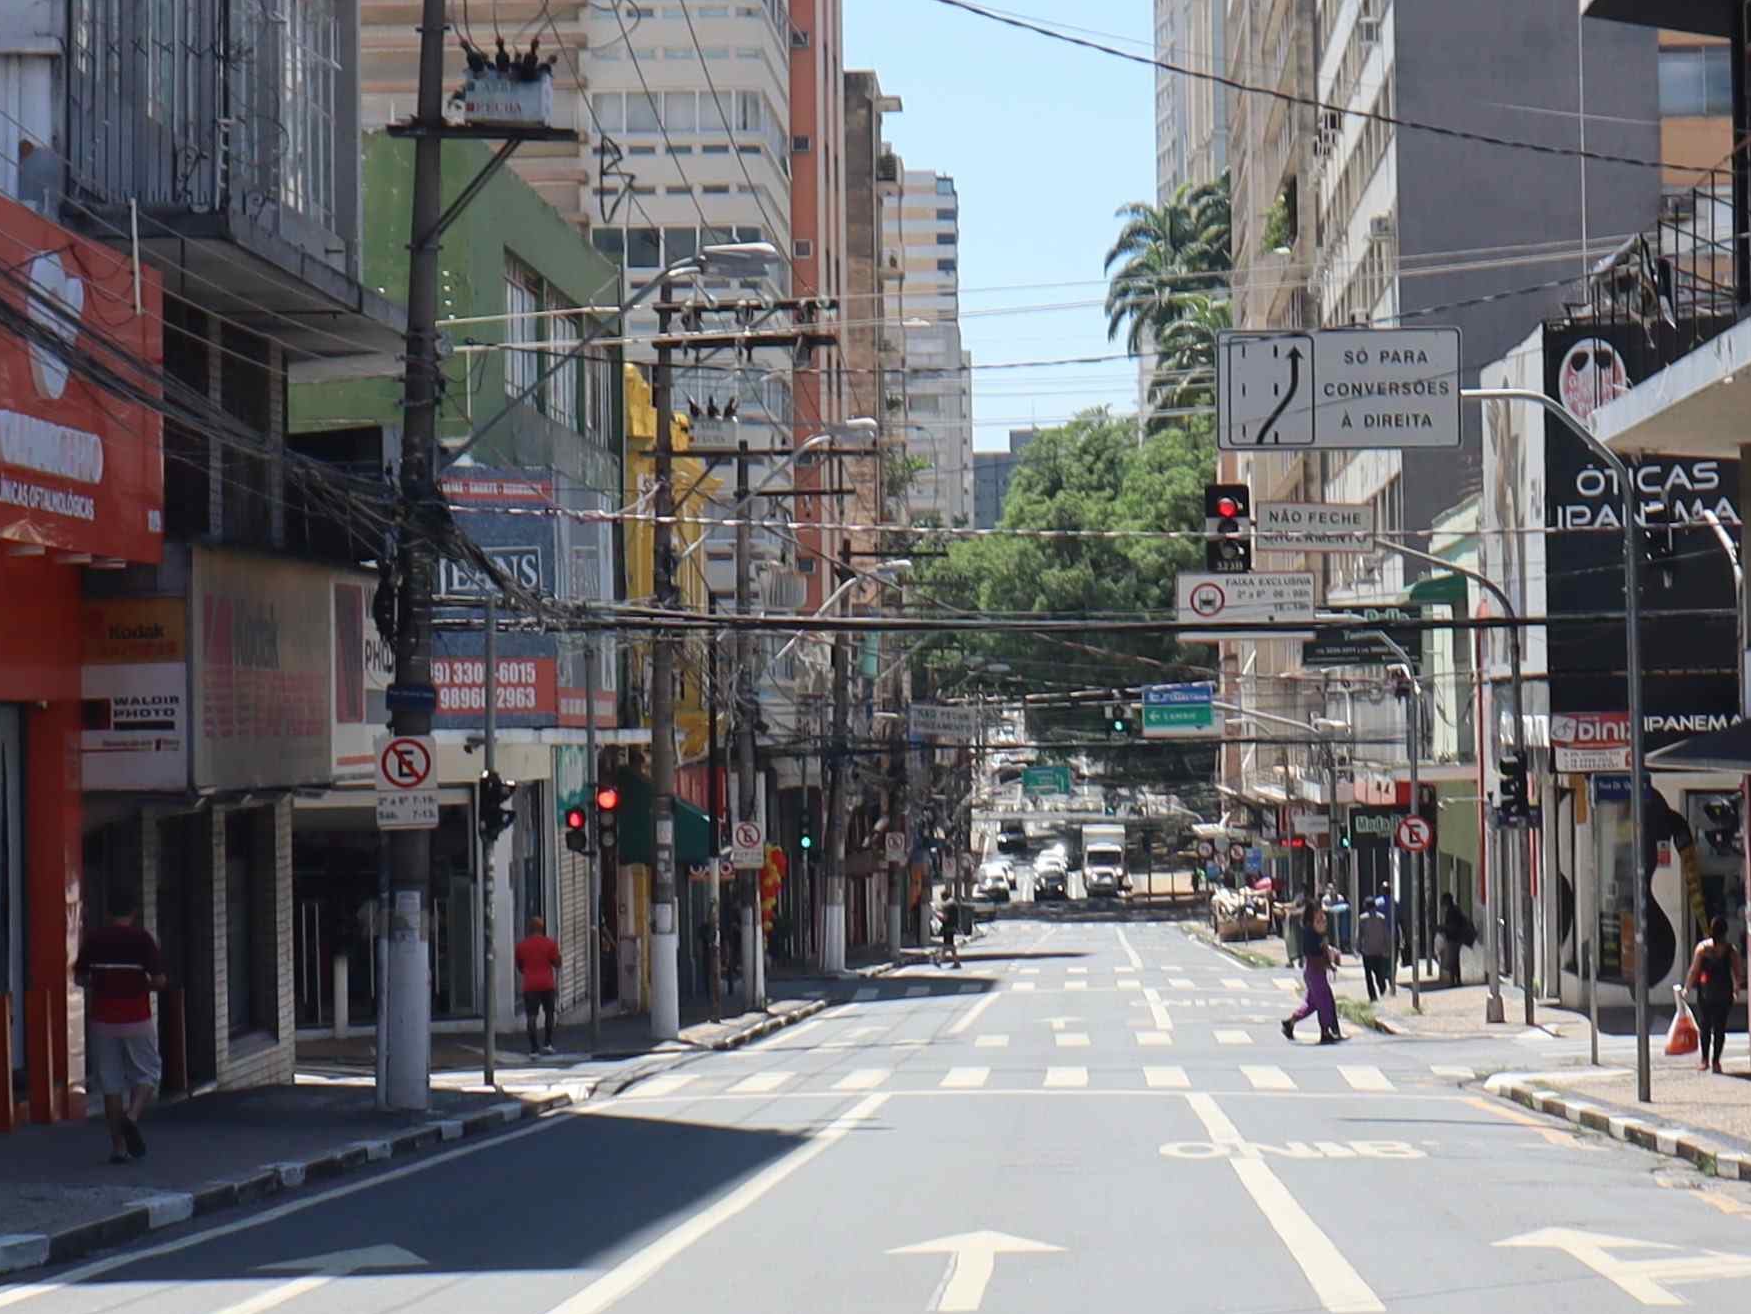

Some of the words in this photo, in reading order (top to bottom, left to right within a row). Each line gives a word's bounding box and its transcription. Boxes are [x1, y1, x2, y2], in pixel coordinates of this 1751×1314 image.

[1344, 348, 1368, 364] SÓ
[1380, 349, 1428, 364] PARA
[1324, 379, 1449, 397] CONVERSÕES
[1341, 413, 1353, 428] À
[1364, 414, 1432, 428] DIREITA
[1269, 507, 1302, 524] NÃO
[1308, 511, 1362, 525] FECHE
[108, 623, 165, 639] Kodak
[113, 694, 180, 707] WALDIR
[113, 707, 176, 720] PHOTO
